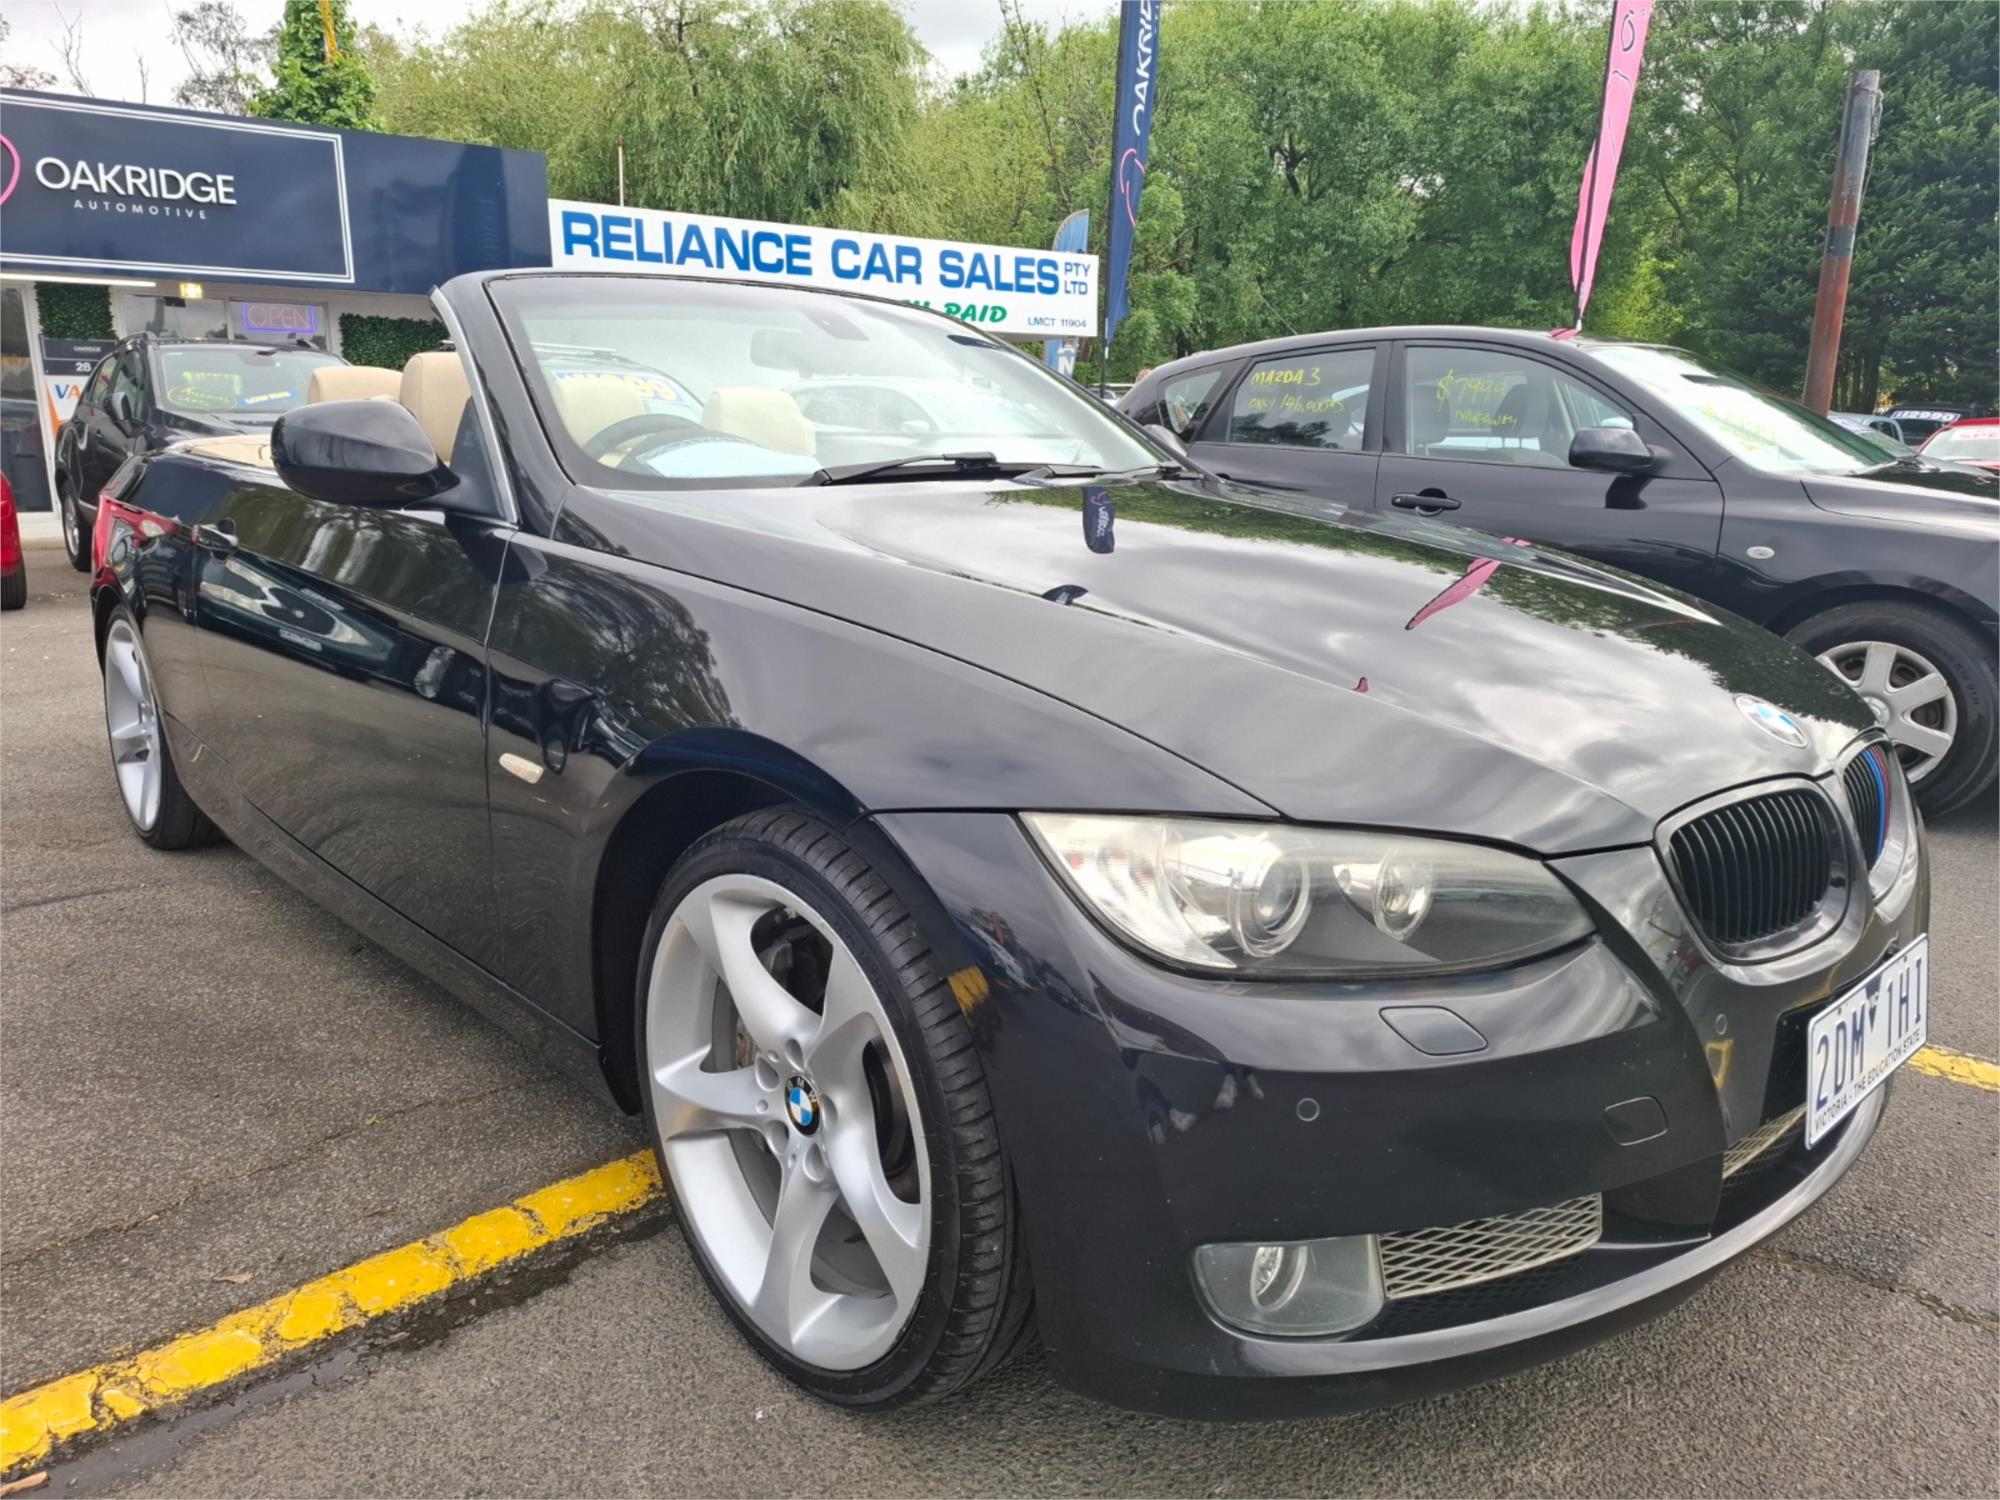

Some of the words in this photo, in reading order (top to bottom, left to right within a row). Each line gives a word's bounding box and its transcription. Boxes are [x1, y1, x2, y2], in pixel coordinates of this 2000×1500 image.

[35, 156, 237, 204] OAKRIDGE
[74, 199, 207, 219] AUTOMOTIVE
[561, 210, 813, 276] RELIANCE
[831, 238, 922, 285] CAR
[939, 249, 1059, 296] SALES
[1064, 262, 1091, 277] PTY
[1064, 281, 1088, 295] LTD
[249, 304, 310, 328] OPEN
[944, 302, 1008, 323] PAID
[1027, 316, 1056, 327] LMCT
[75, 362, 92, 372] 28
[1250, 369, 1304, 385] MAZDA
[1305, 367, 1321, 386] 3
[786, 1077, 817, 1102] BMW
[1815, 1093, 1848, 1131] VICTORIA
[1854, 1074, 1866, 1096] THE
